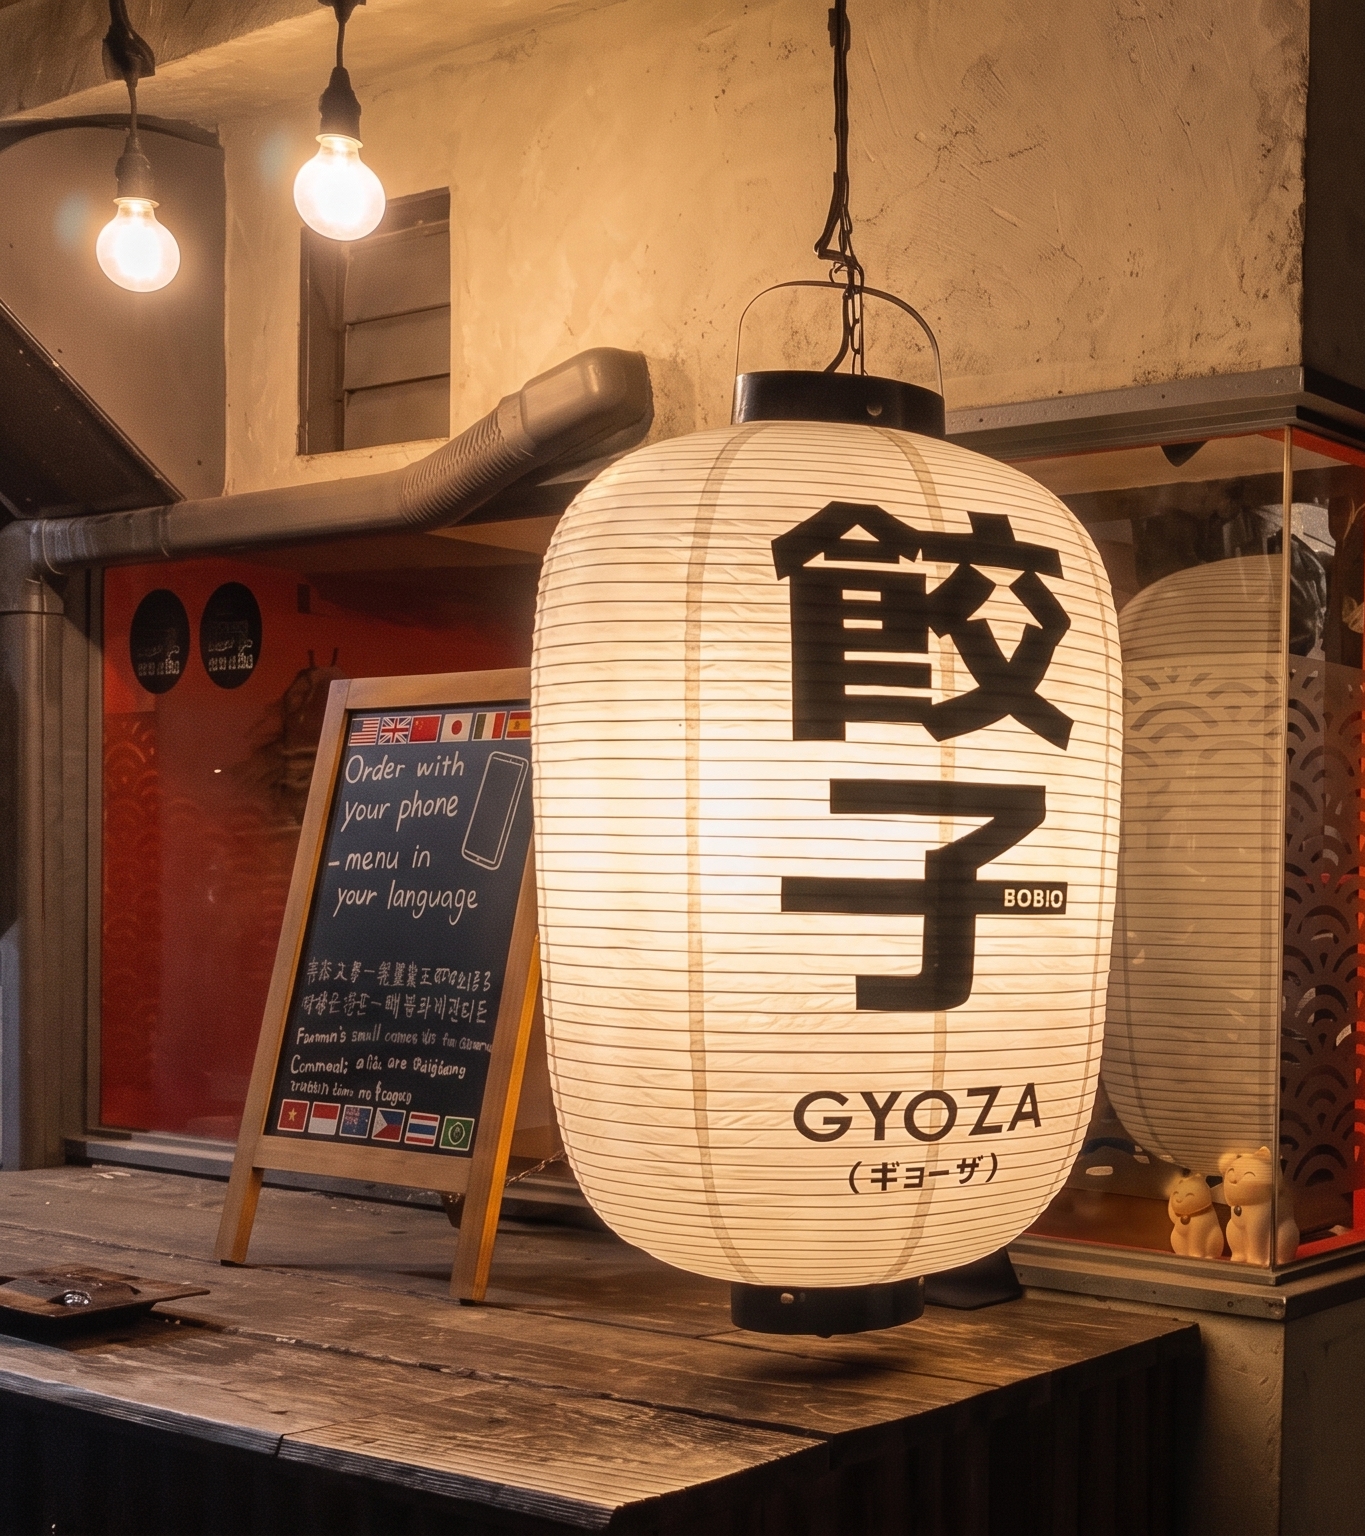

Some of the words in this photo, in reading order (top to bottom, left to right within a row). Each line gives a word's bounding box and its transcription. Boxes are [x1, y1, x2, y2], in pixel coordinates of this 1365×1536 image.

[345, 754, 405, 783] Order
[417, 751, 464, 777] with
[771, 501, 1075, 1011] 餃子
[341, 801, 390, 832] your
[396, 790, 459, 832] phone
[345, 849, 399, 871] menu
[412, 845, 431, 869] in
[333, 885, 377, 917] your
[387, 880, 478, 925] language
[1004, 889, 1064, 909] BOBIO
[793, 1082, 1042, 1143] GYOZA
